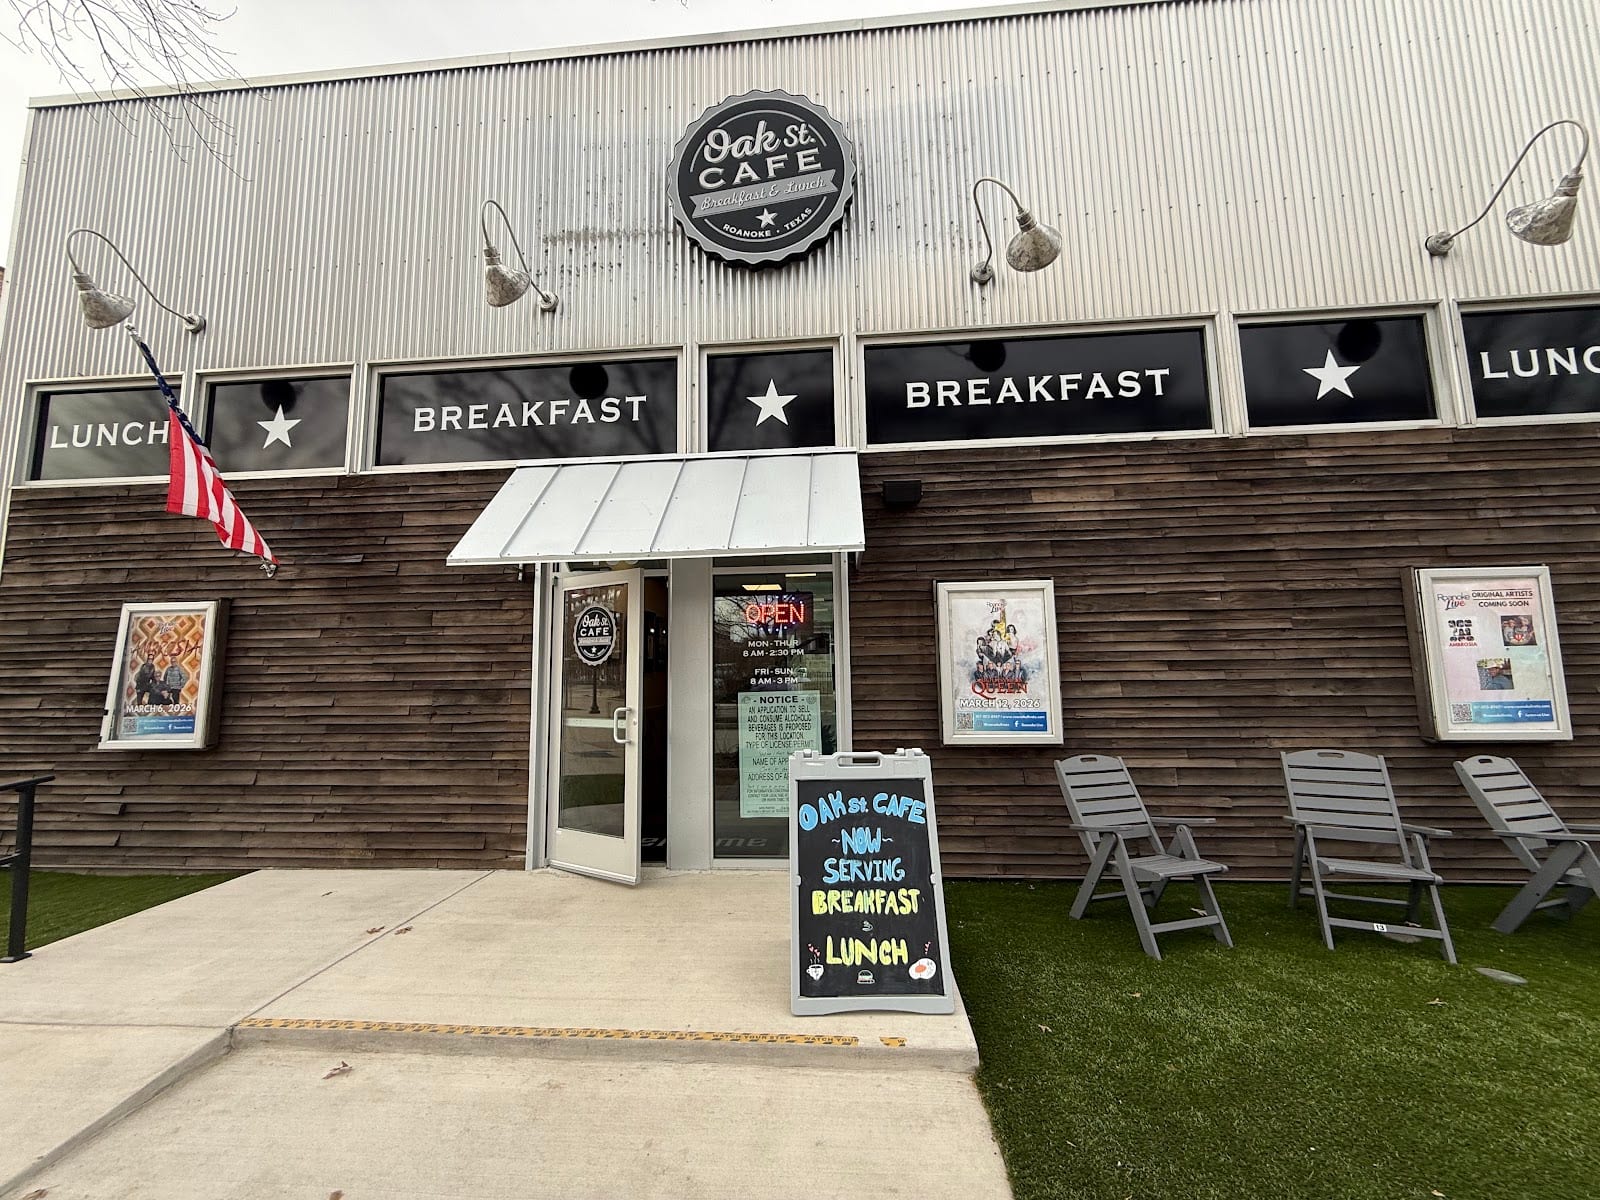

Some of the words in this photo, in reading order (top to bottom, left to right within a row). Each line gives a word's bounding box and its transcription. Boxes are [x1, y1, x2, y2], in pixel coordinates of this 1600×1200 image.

[703, 120, 781, 163] Oak
[783, 122, 816, 148] St.
[698, 148, 822, 190] CAFE
[700, 187, 767, 210] Breakfast
[769, 184, 780, 197] &
[784, 176, 826, 194] Lunch
[722, 224, 772, 238] ROANOKE
[784, 207, 812, 230] TEXAS
[906, 368, 1170, 408] BREAKFAST
[414, 395, 647, 432] BREAKFAST
[50, 420, 170, 449] LUNCH
[1437, 592, 1470, 601] Roanoke
[1444, 600, 1466, 610] Live
[582, 614, 600, 627] Oak
[746, 604, 804, 623] OPEN
[580, 627, 610, 636] CAFE
[972, 680, 1028, 700] QUEEN
[126, 704, 156, 713] MARCH
[168, 704, 192, 712] 2026
[960, 699, 996, 708] MARCH
[1014, 699, 1040, 708] 2026
[748, 724, 776, 732] BEVERAGES
[786, 723, 811, 731] PROPOSED
[753, 758, 768, 766] NAME
[748, 773, 773, 781] ADDRESS
[799, 790, 846, 831] OAK
[872, 792, 926, 824] CAFE
[822, 857, 906, 884] SERVING
[812, 888, 921, 916] BREAKFAST
[826, 935, 909, 966] LUNCH
